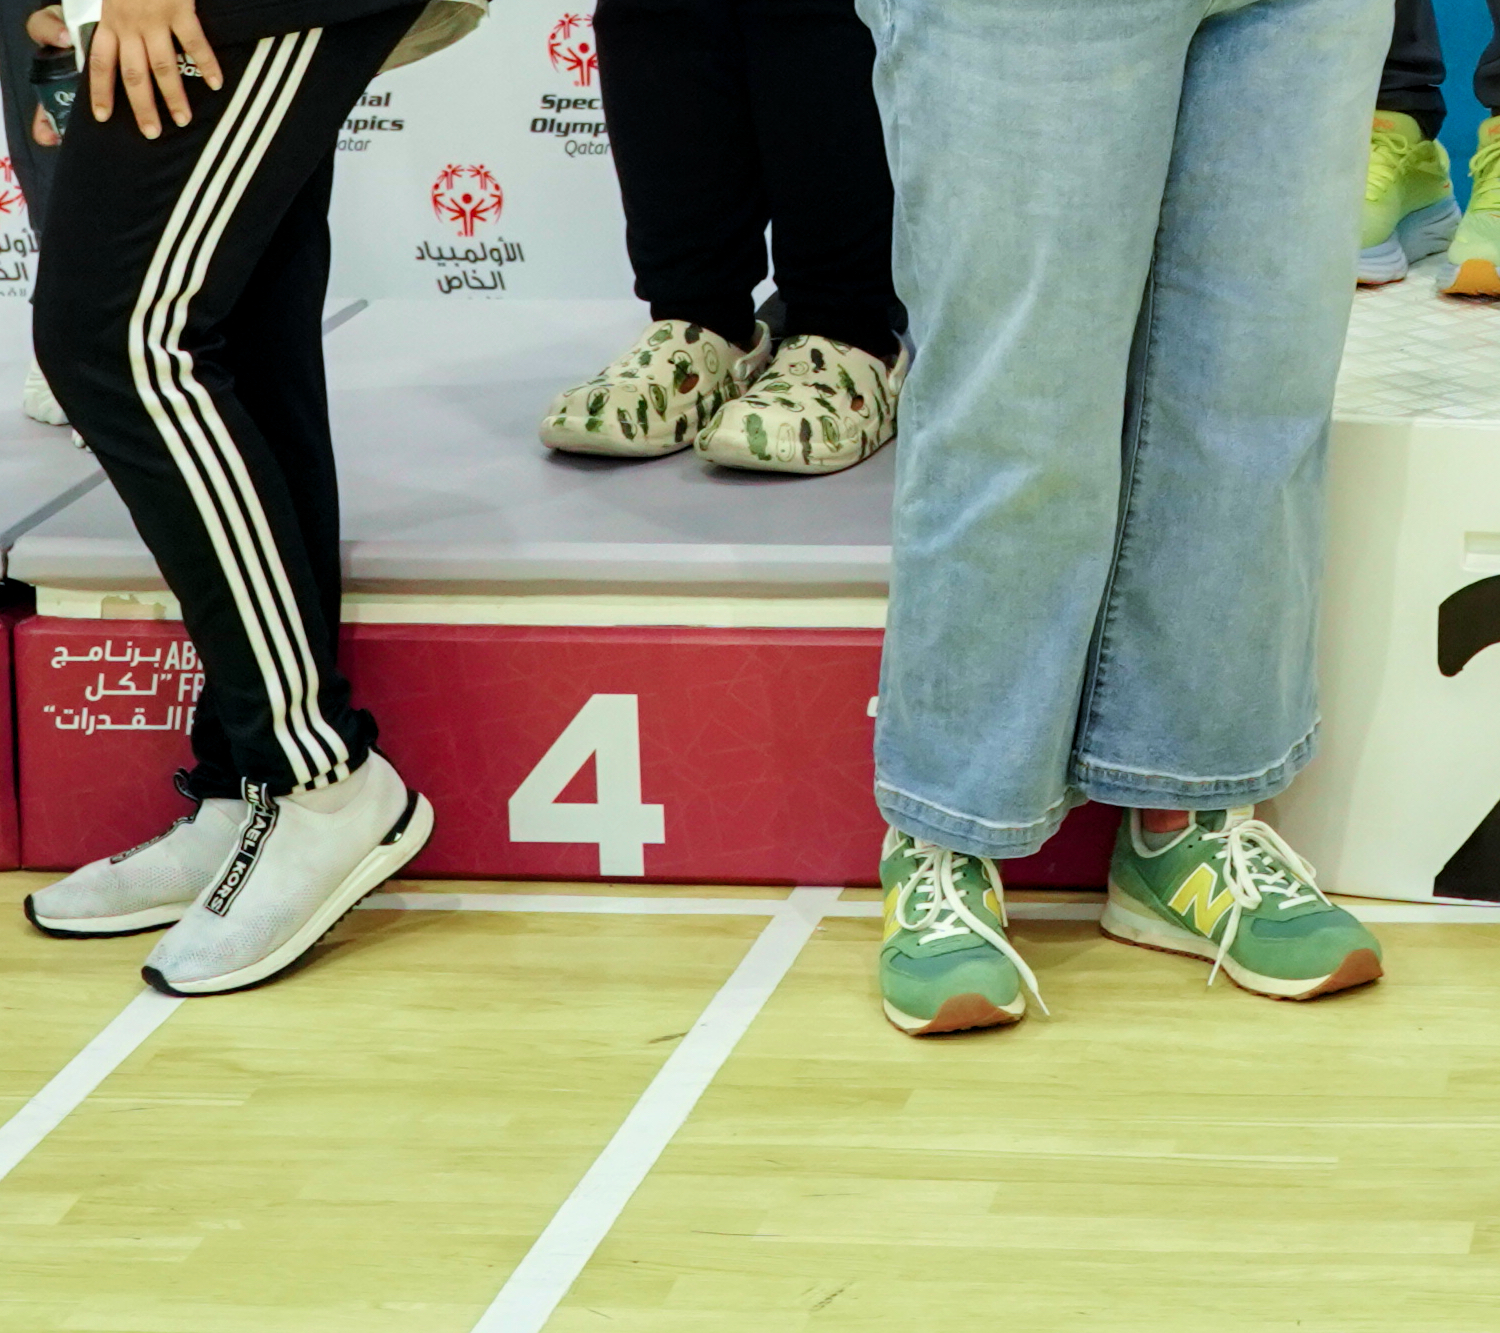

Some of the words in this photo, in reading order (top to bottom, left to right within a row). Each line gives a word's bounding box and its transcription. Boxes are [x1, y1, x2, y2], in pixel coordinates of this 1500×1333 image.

[416, 237, 525, 267] الأولمبياد
[437, 269, 506, 294] الخاص
[51, 639, 162, 669] برنامج
[509, 694, 665, 876] 4
[209, 860, 247, 913] KORS
